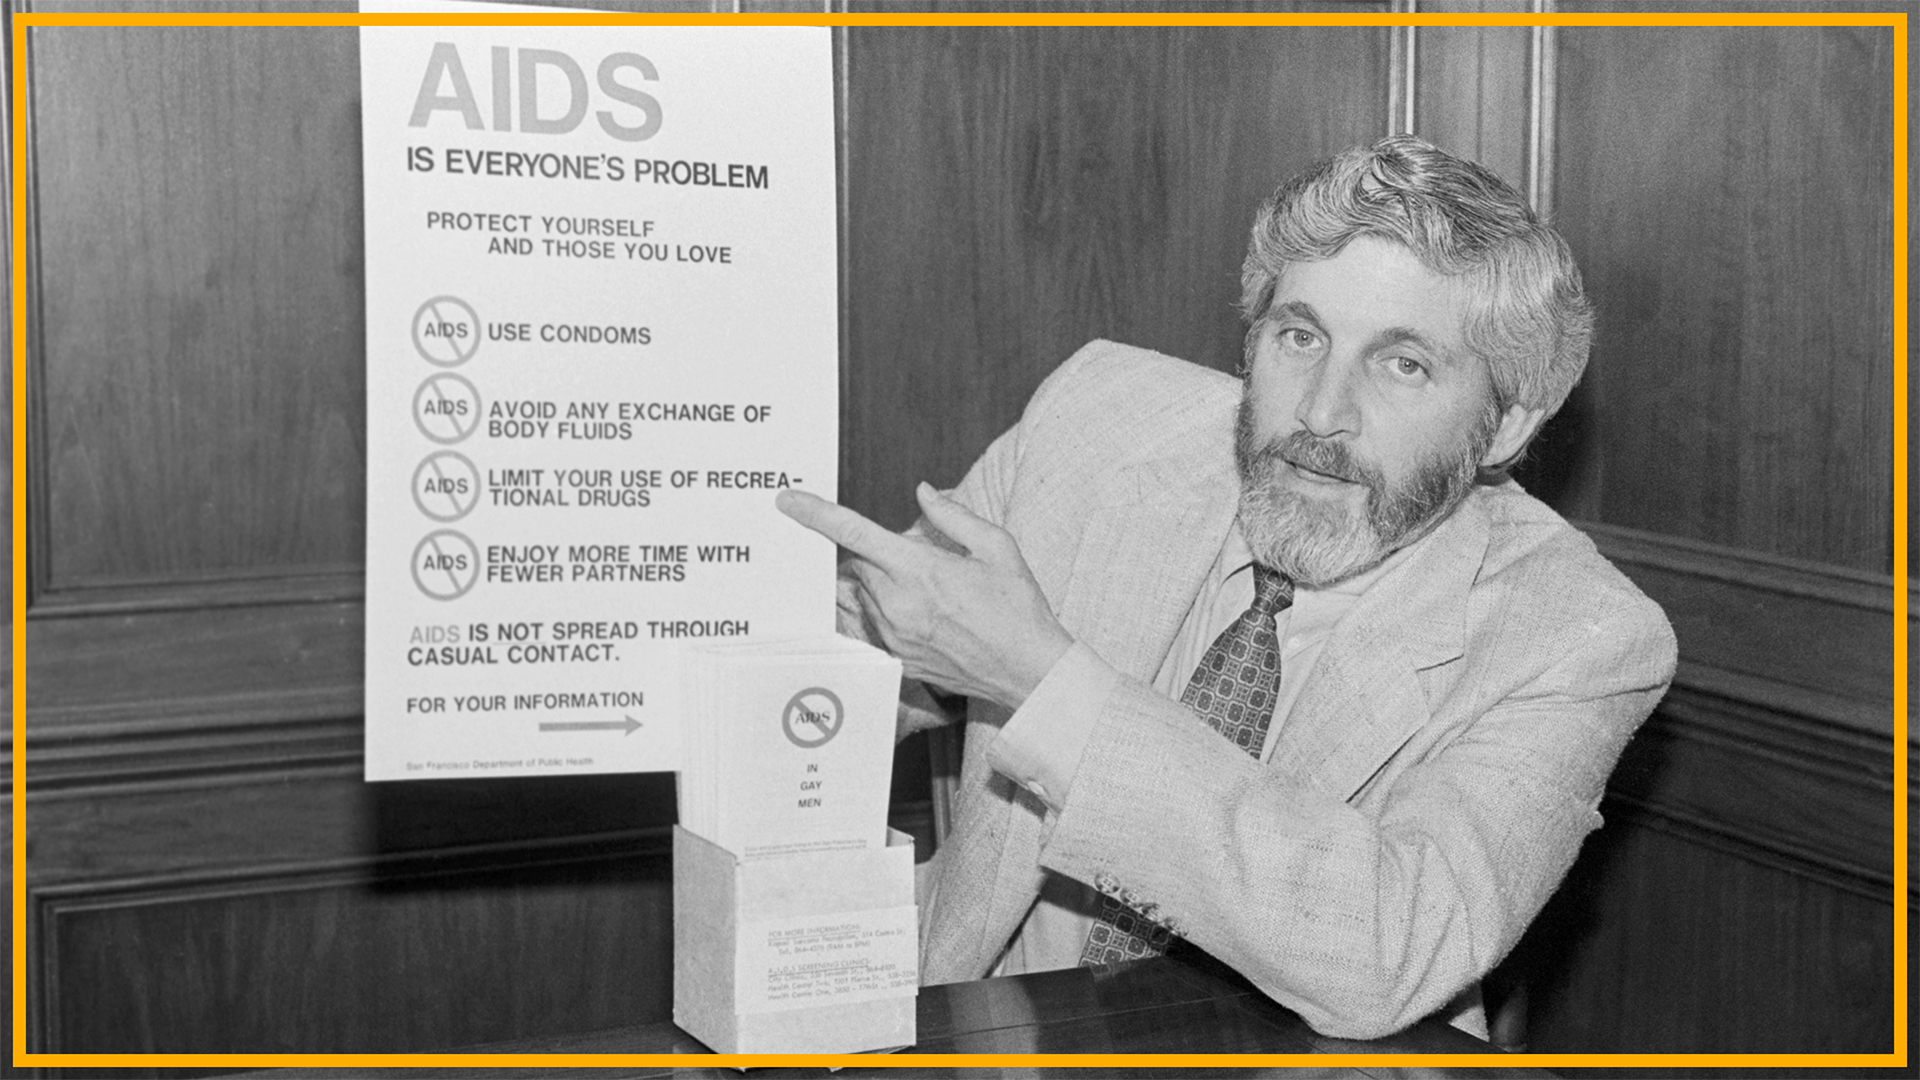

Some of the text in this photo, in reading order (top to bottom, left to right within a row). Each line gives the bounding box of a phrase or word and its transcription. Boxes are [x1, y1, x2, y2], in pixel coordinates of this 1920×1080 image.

[407, 41, 664, 142] AIDS
[407, 147, 769, 190] IS EVERYONE'S PROBLEM
[427, 211, 655, 238] PROTECT YOURSELF
[488, 237, 732, 264] AND THOSE YOU LOVE
[424, 322, 468, 338] AIDS
[488, 323, 652, 345] USE CONDOMS
[424, 399, 468, 415] AIDS
[489, 401, 772, 423] AVOID ANY EXCHANGE OF
[488, 420, 633, 440] BODY FLUIDS
[424, 478, 469, 494] AIDS
[489, 469, 803, 489] LIMIT YOUR USE OF RECREA-
[489, 489, 651, 507] TIONAL DRUGS
[423, 555, 467, 571] AIDS
[487, 545, 750, 563] ENJOY MORE TIME WITH
[487, 564, 686, 582] FEWER PARTNERS
[409, 620, 749, 644] AIDS IS NOT SPREAD THROUGH
[408, 644, 620, 666] CASUAL CONTACT.
[407, 692, 644, 713] FOR YOUR INFORMATION
[794, 710, 831, 725] AIDS
[406, 756, 594, 771] San Francisco Department of Public Health
[807, 763, 818, 773] IN
[800, 781, 822, 791] GAY
[798, 798, 821, 808] MEN
[769, 930, 783, 938] FOR
[785, 928, 805, 937] MORE
[798, 961, 840, 972] SCREENING
[768, 983, 790, 992] Health
[792, 981, 813, 990] Center
[768, 992, 790, 1000] Health
[792, 990, 813, 999] Center
